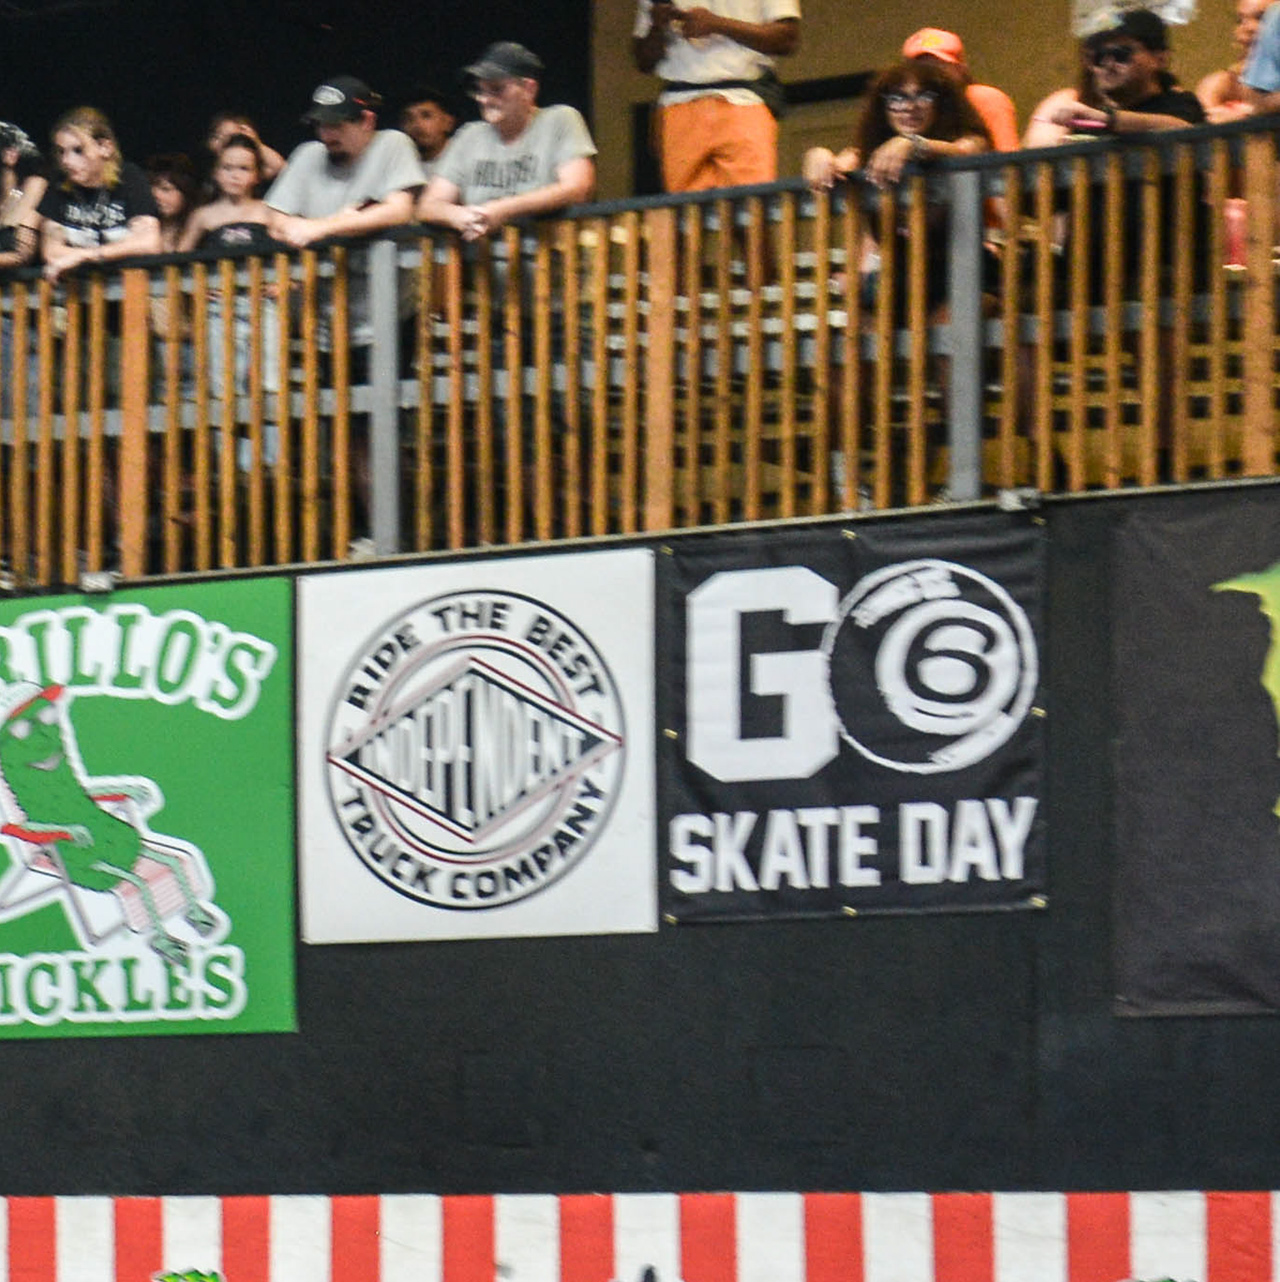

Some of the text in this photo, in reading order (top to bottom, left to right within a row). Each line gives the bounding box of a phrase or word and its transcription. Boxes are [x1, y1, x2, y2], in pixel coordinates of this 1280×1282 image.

[348, 600, 605, 712] RIDE THE BEST
[342, 776, 606, 900] TRUCK COMPANY
[668, 796, 1039, 894] SKATE DAY
